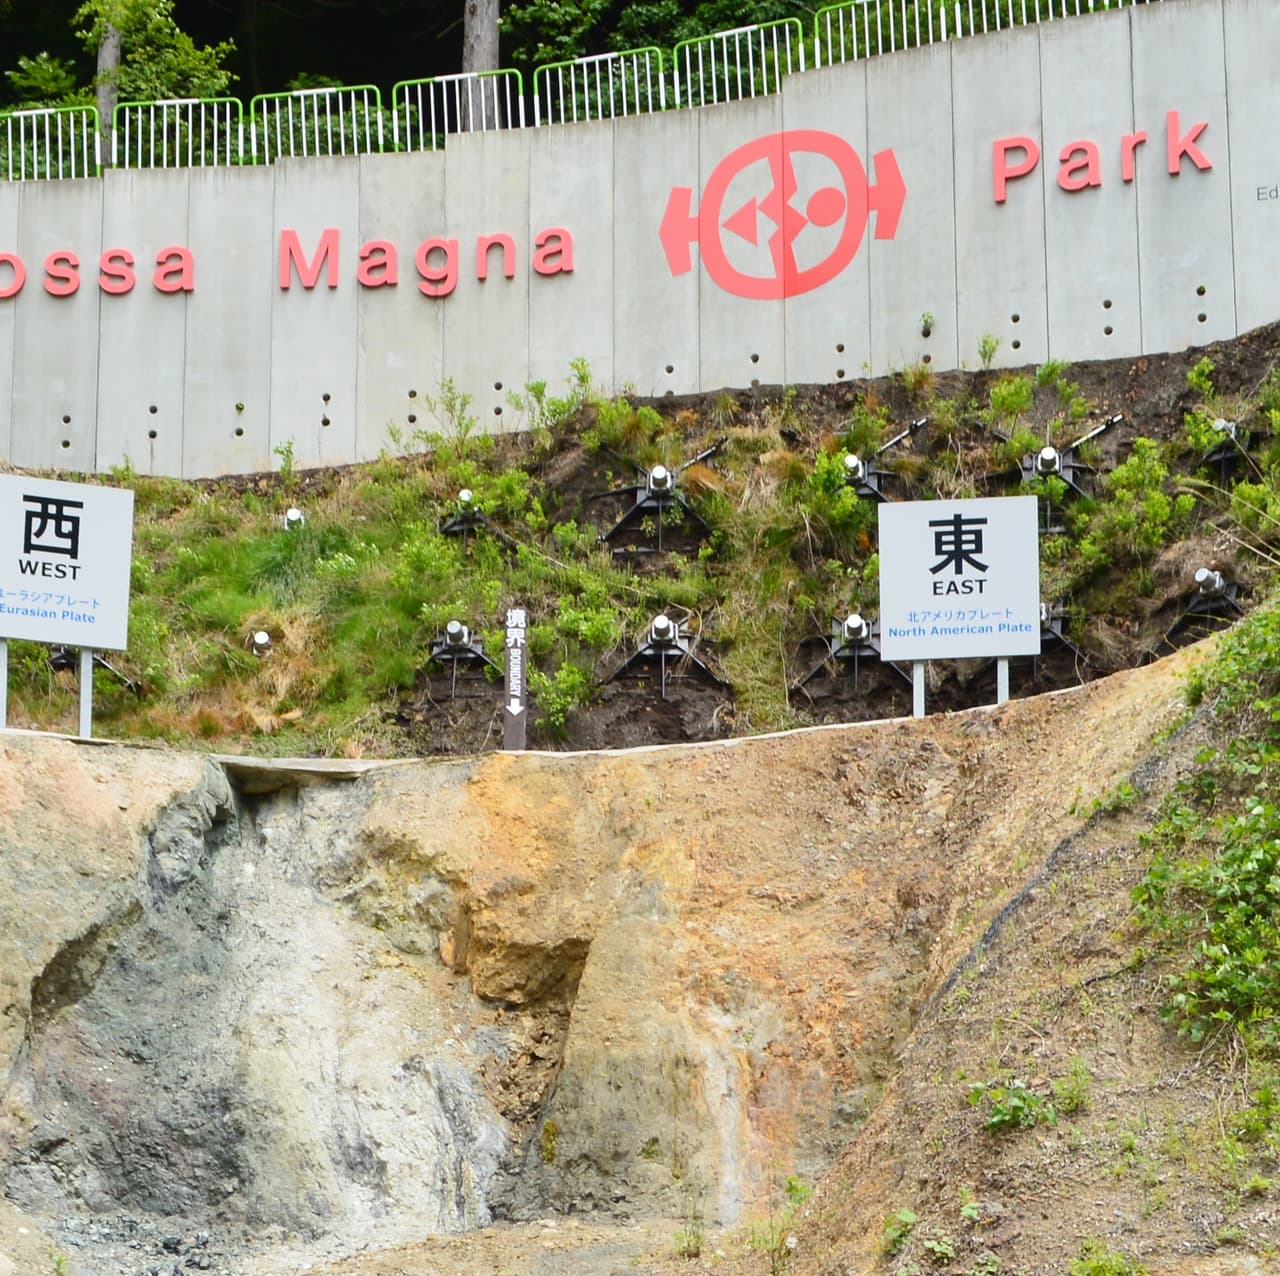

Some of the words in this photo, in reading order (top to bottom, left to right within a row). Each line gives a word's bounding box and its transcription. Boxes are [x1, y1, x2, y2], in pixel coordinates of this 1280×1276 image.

[279, 227, 575, 298] Magna
[992, 110, 1212, 204] Park
[22, 494, 84, 560] 西
[929, 513, 989, 575] 東
[18, 559, 82, 581] WEST
[932, 579, 988, 596] EAST
[61, 609, 96, 624] Plate
[506, 608, 526, 648] 境界
[888, 625, 926, 638] North
[930, 624, 993, 636] American
[998, 622, 1033, 633] Plate
[907, 607, 1014, 624] 北アメリカプレート
[509, 648, 522, 696] BOUNDARY
